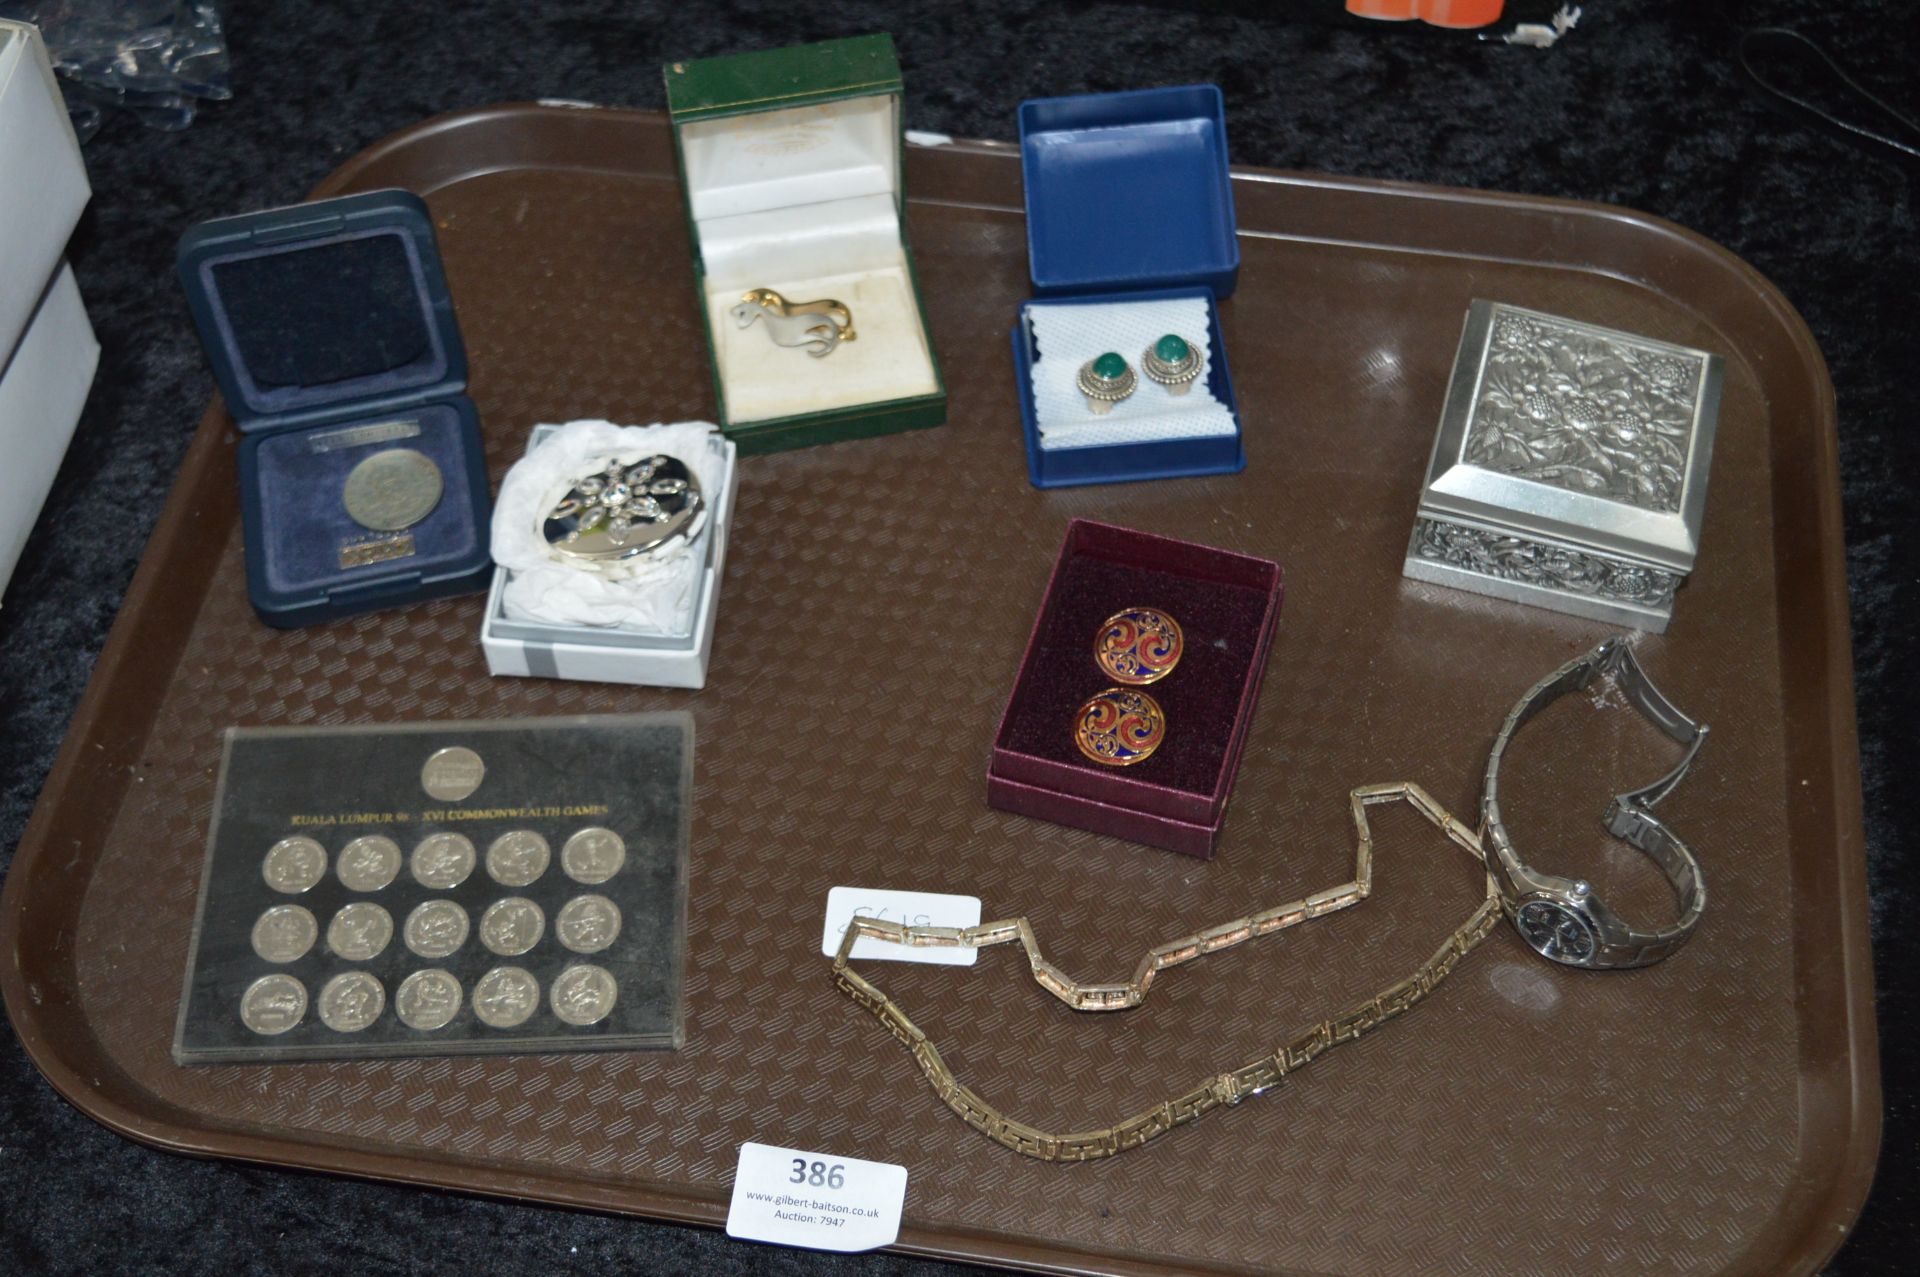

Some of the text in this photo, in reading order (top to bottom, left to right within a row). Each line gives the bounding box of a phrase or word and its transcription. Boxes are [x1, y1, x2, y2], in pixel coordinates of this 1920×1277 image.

[292, 815, 336, 825] KUALA
[340, 813, 393, 824] LUMPUR
[423, 810, 445, 821] XVI
[448, 808, 560, 820] COMMONWEALTH
[563, 805, 608, 815] GAMES
[789, 1158, 845, 1190] 386
[746, 1191, 879, 1218] www.gilbert-baitson.co.uk
[774, 1209, 845, 1228] Auction: 7947
